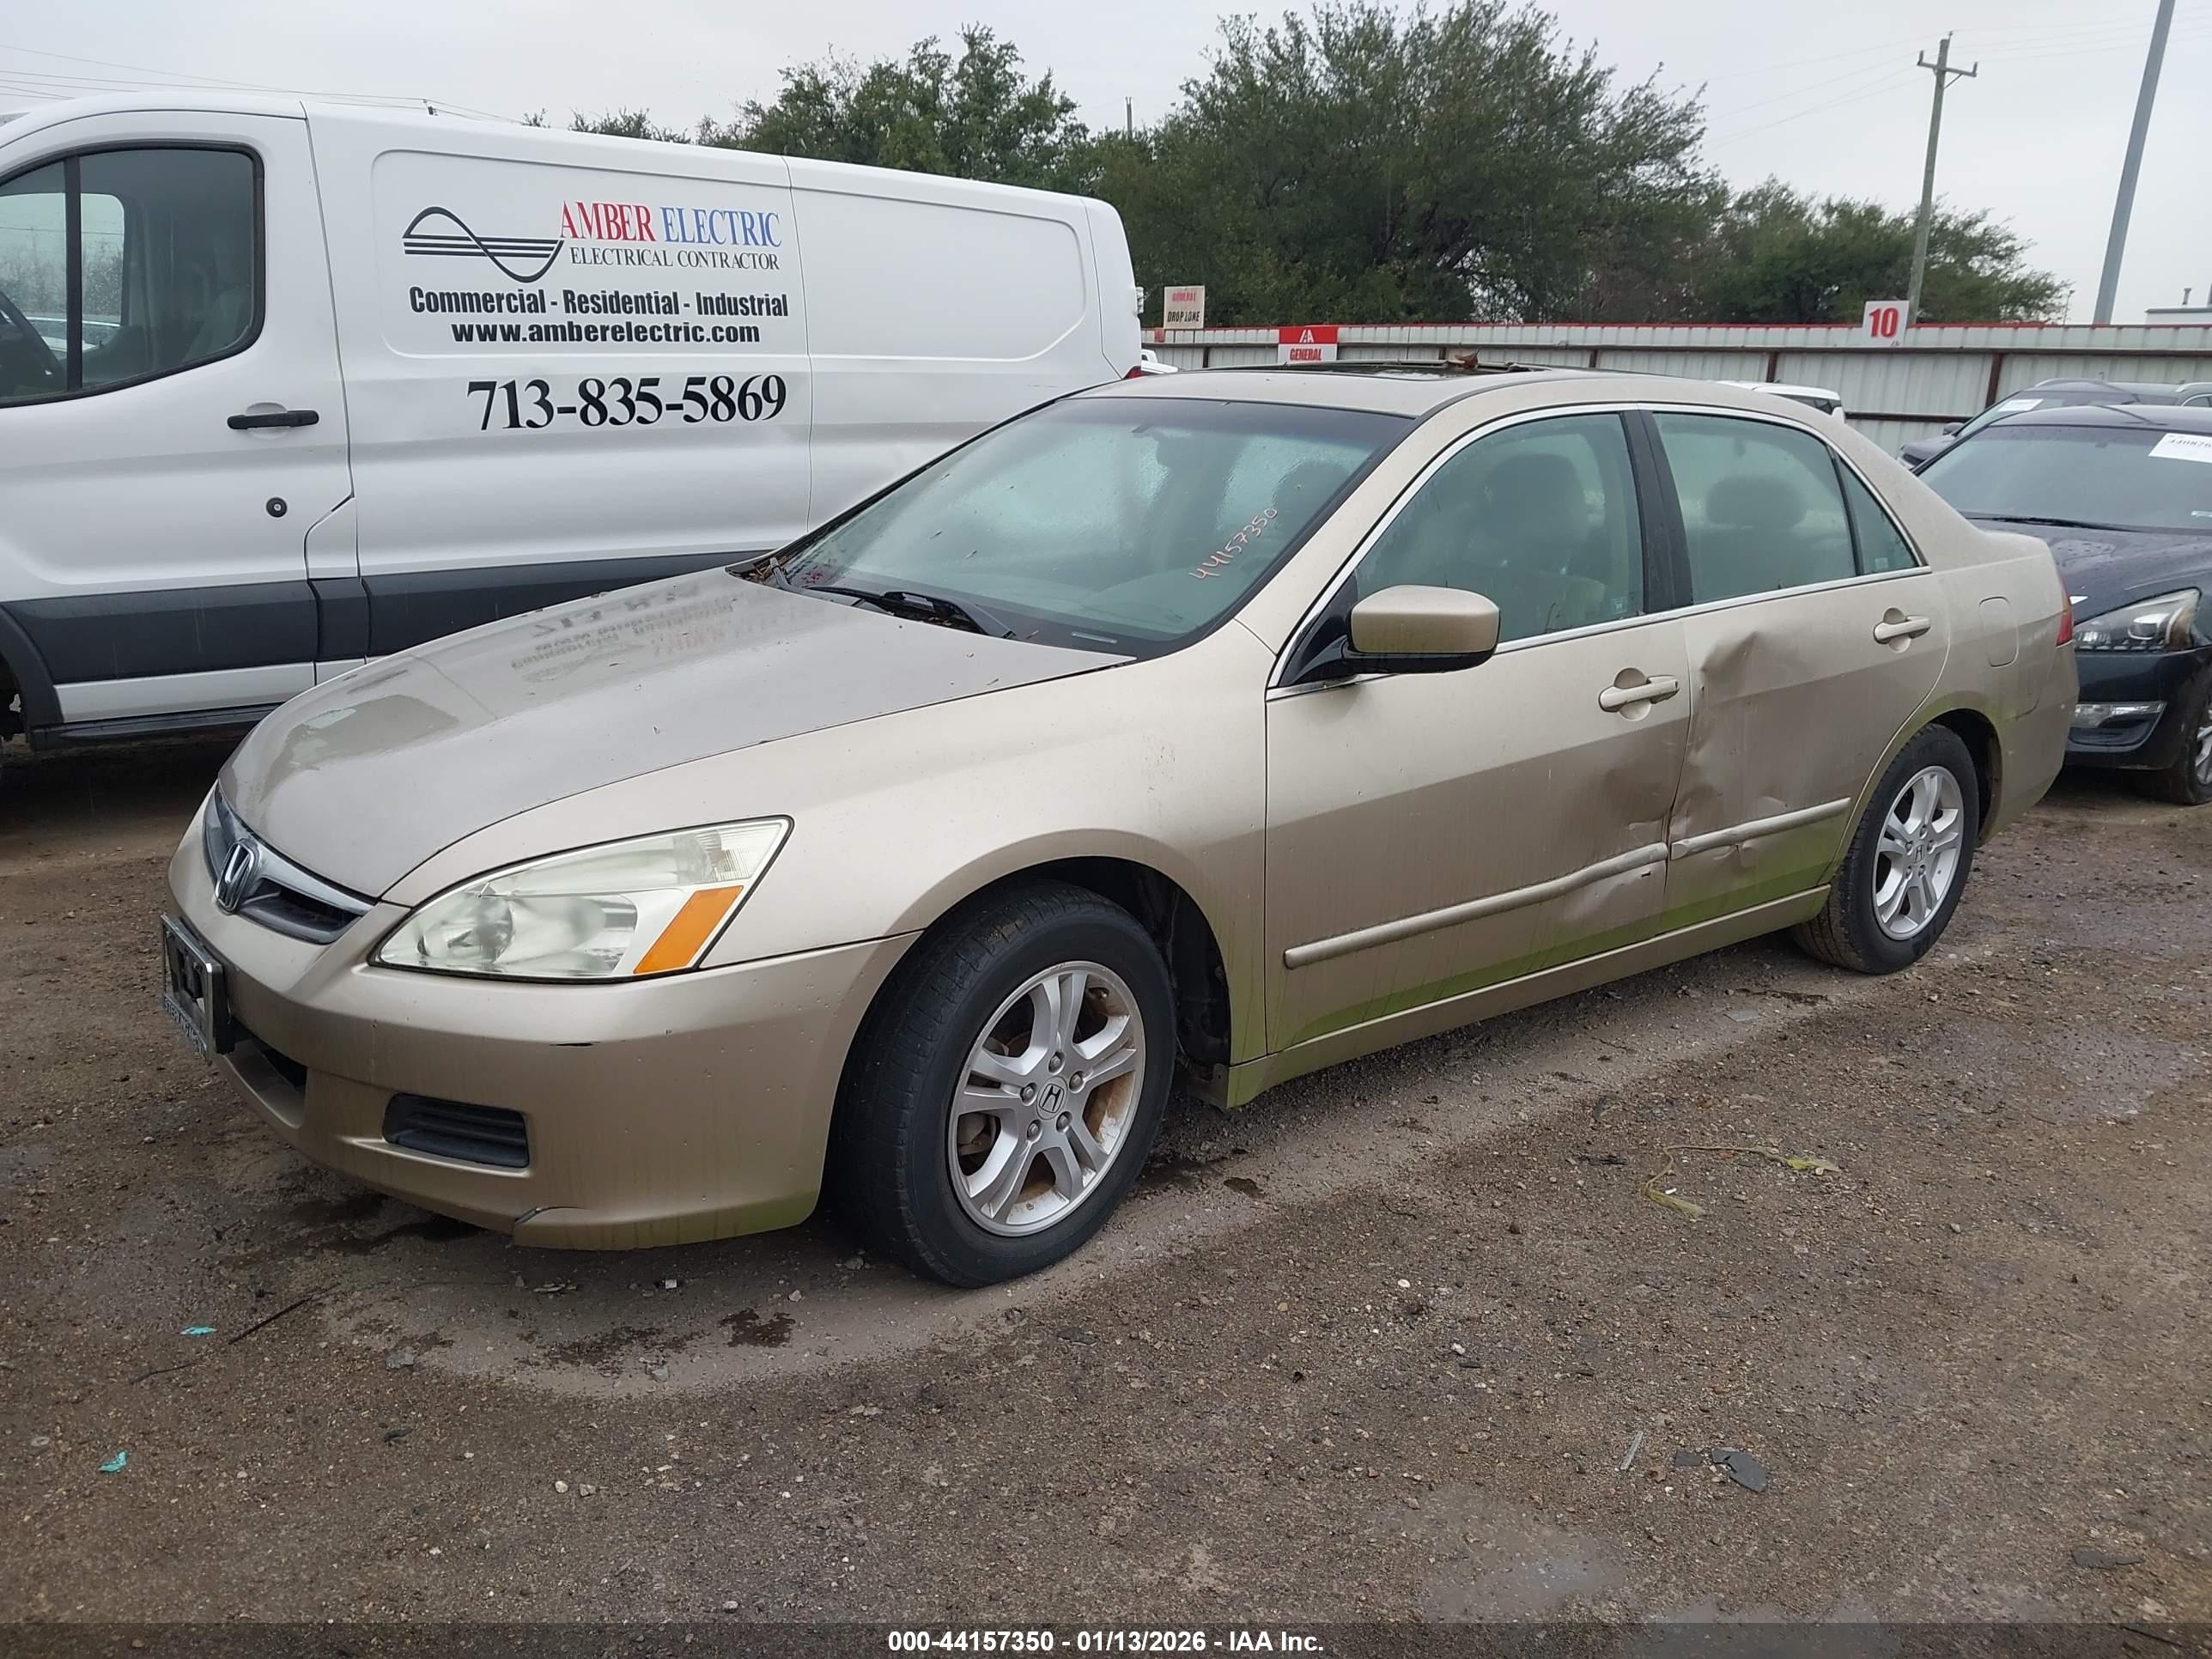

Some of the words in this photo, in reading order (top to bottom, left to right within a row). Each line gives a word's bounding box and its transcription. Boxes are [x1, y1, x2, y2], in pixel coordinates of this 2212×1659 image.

[560, 200, 657, 242] AMBER
[659, 206, 782, 247] ELECTRIC
[569, 246, 674, 268] ELECTRICAL
[677, 250, 781, 270] CONTRACTOR
[409, 286, 546, 314] Commercial
[562, 289, 680, 316] Residential
[695, 291, 789, 318] Industrial
[1167, 311, 1184, 323] DROP
[451, 321, 761, 343] www.amberelectric.com
[1868, 307, 1899, 337] 10
[1290, 348, 1322, 361] GENERAL
[465, 374, 787, 431] 713-835-5869
[1188, 507, 1278, 579] 44157350
